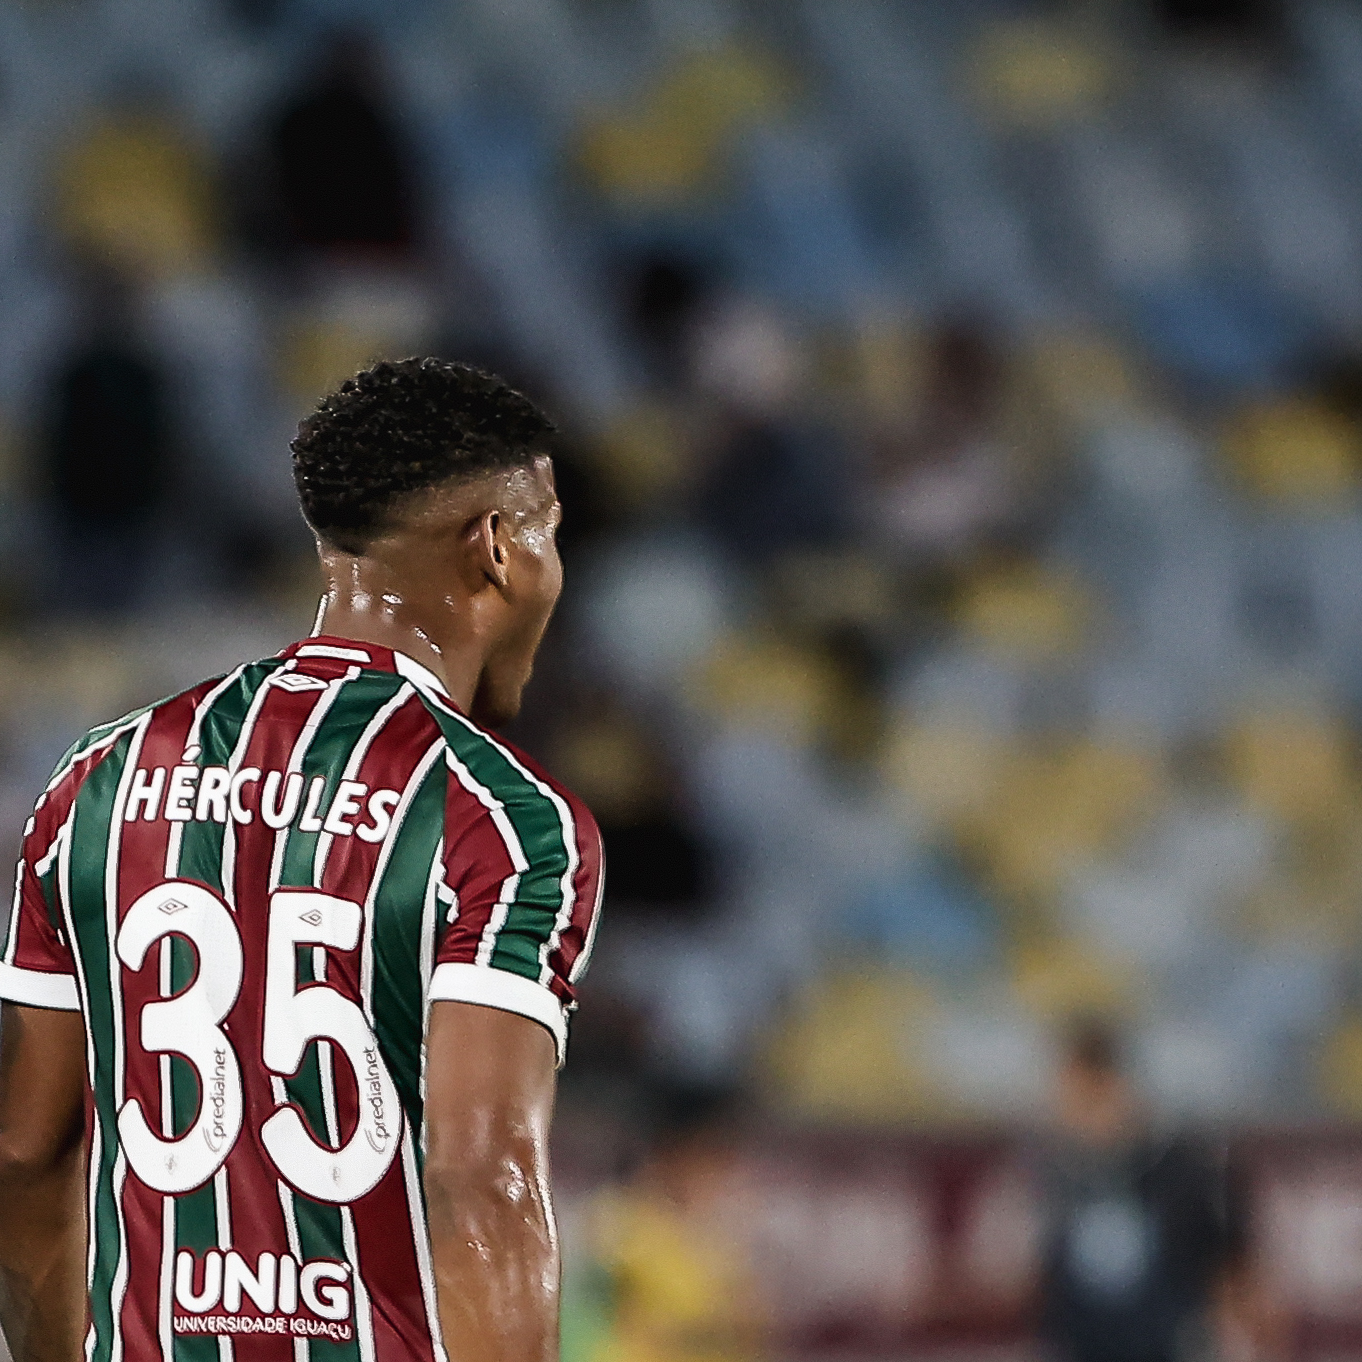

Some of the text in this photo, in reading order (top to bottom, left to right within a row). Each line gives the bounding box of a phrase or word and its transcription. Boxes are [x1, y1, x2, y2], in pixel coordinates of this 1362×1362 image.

[123, 746, 402, 844] HÉRCULES
[116, 878, 405, 1204] 35
[209, 1047, 227, 1138] predialnet
[363, 1046, 391, 1139] predialnet
[173, 1315, 353, 1341] UNIVERSIDADE IGUAÇU
[177, 1249, 354, 1318] UNIG
